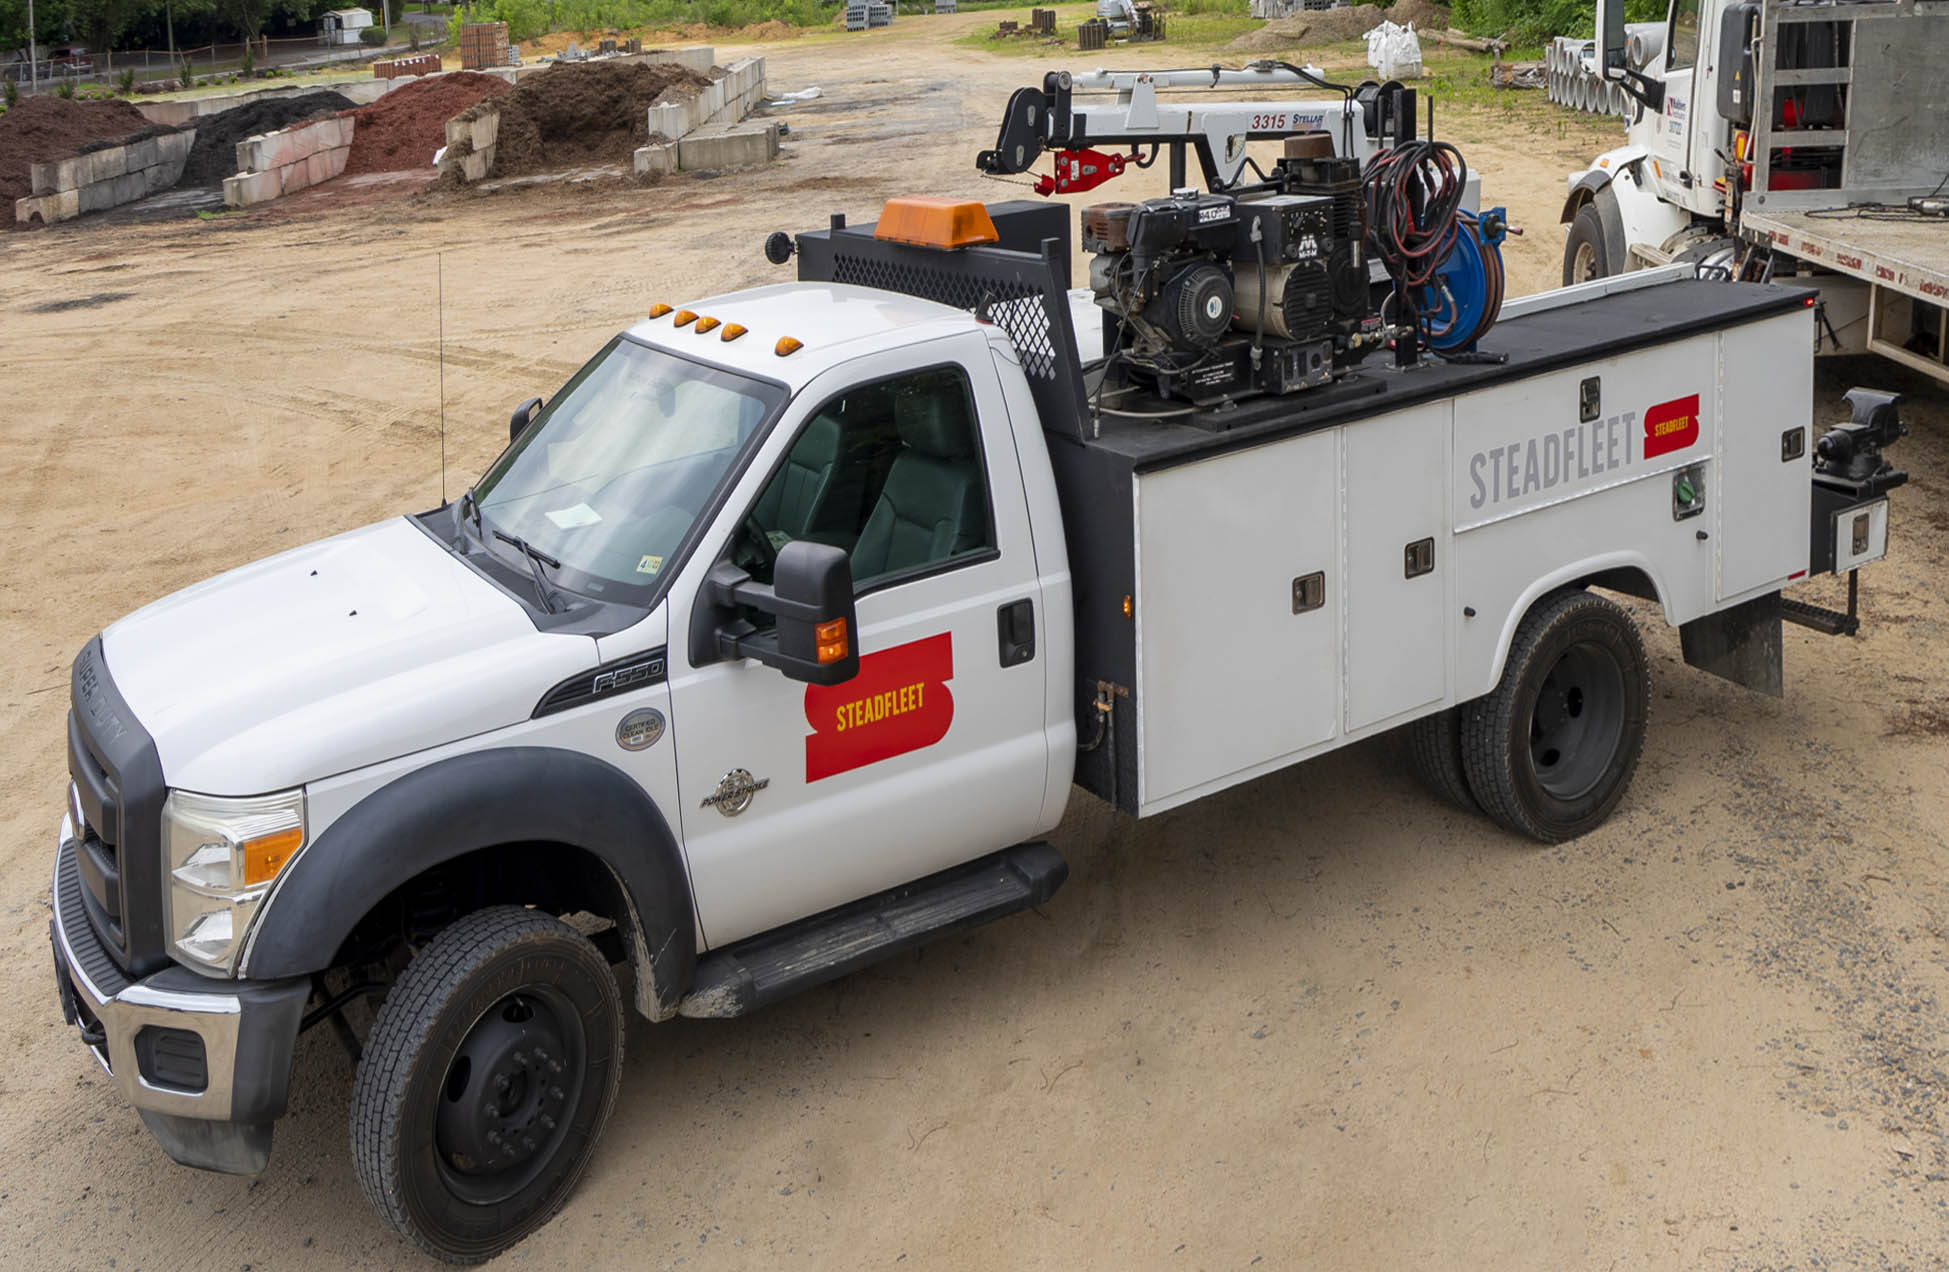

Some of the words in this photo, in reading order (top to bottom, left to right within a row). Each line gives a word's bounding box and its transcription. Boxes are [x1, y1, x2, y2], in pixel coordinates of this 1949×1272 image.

[1251, 113, 1287, 129] 3315
[1654, 415, 1690, 438] STEADFLEET
[1469, 411, 1636, 510] STEADFLEET
[79, 650, 99, 703] SUPER
[592, 657, 665, 695] F-550
[88, 695, 129, 745] DUTY
[836, 682, 925, 732] STEADFLEET
